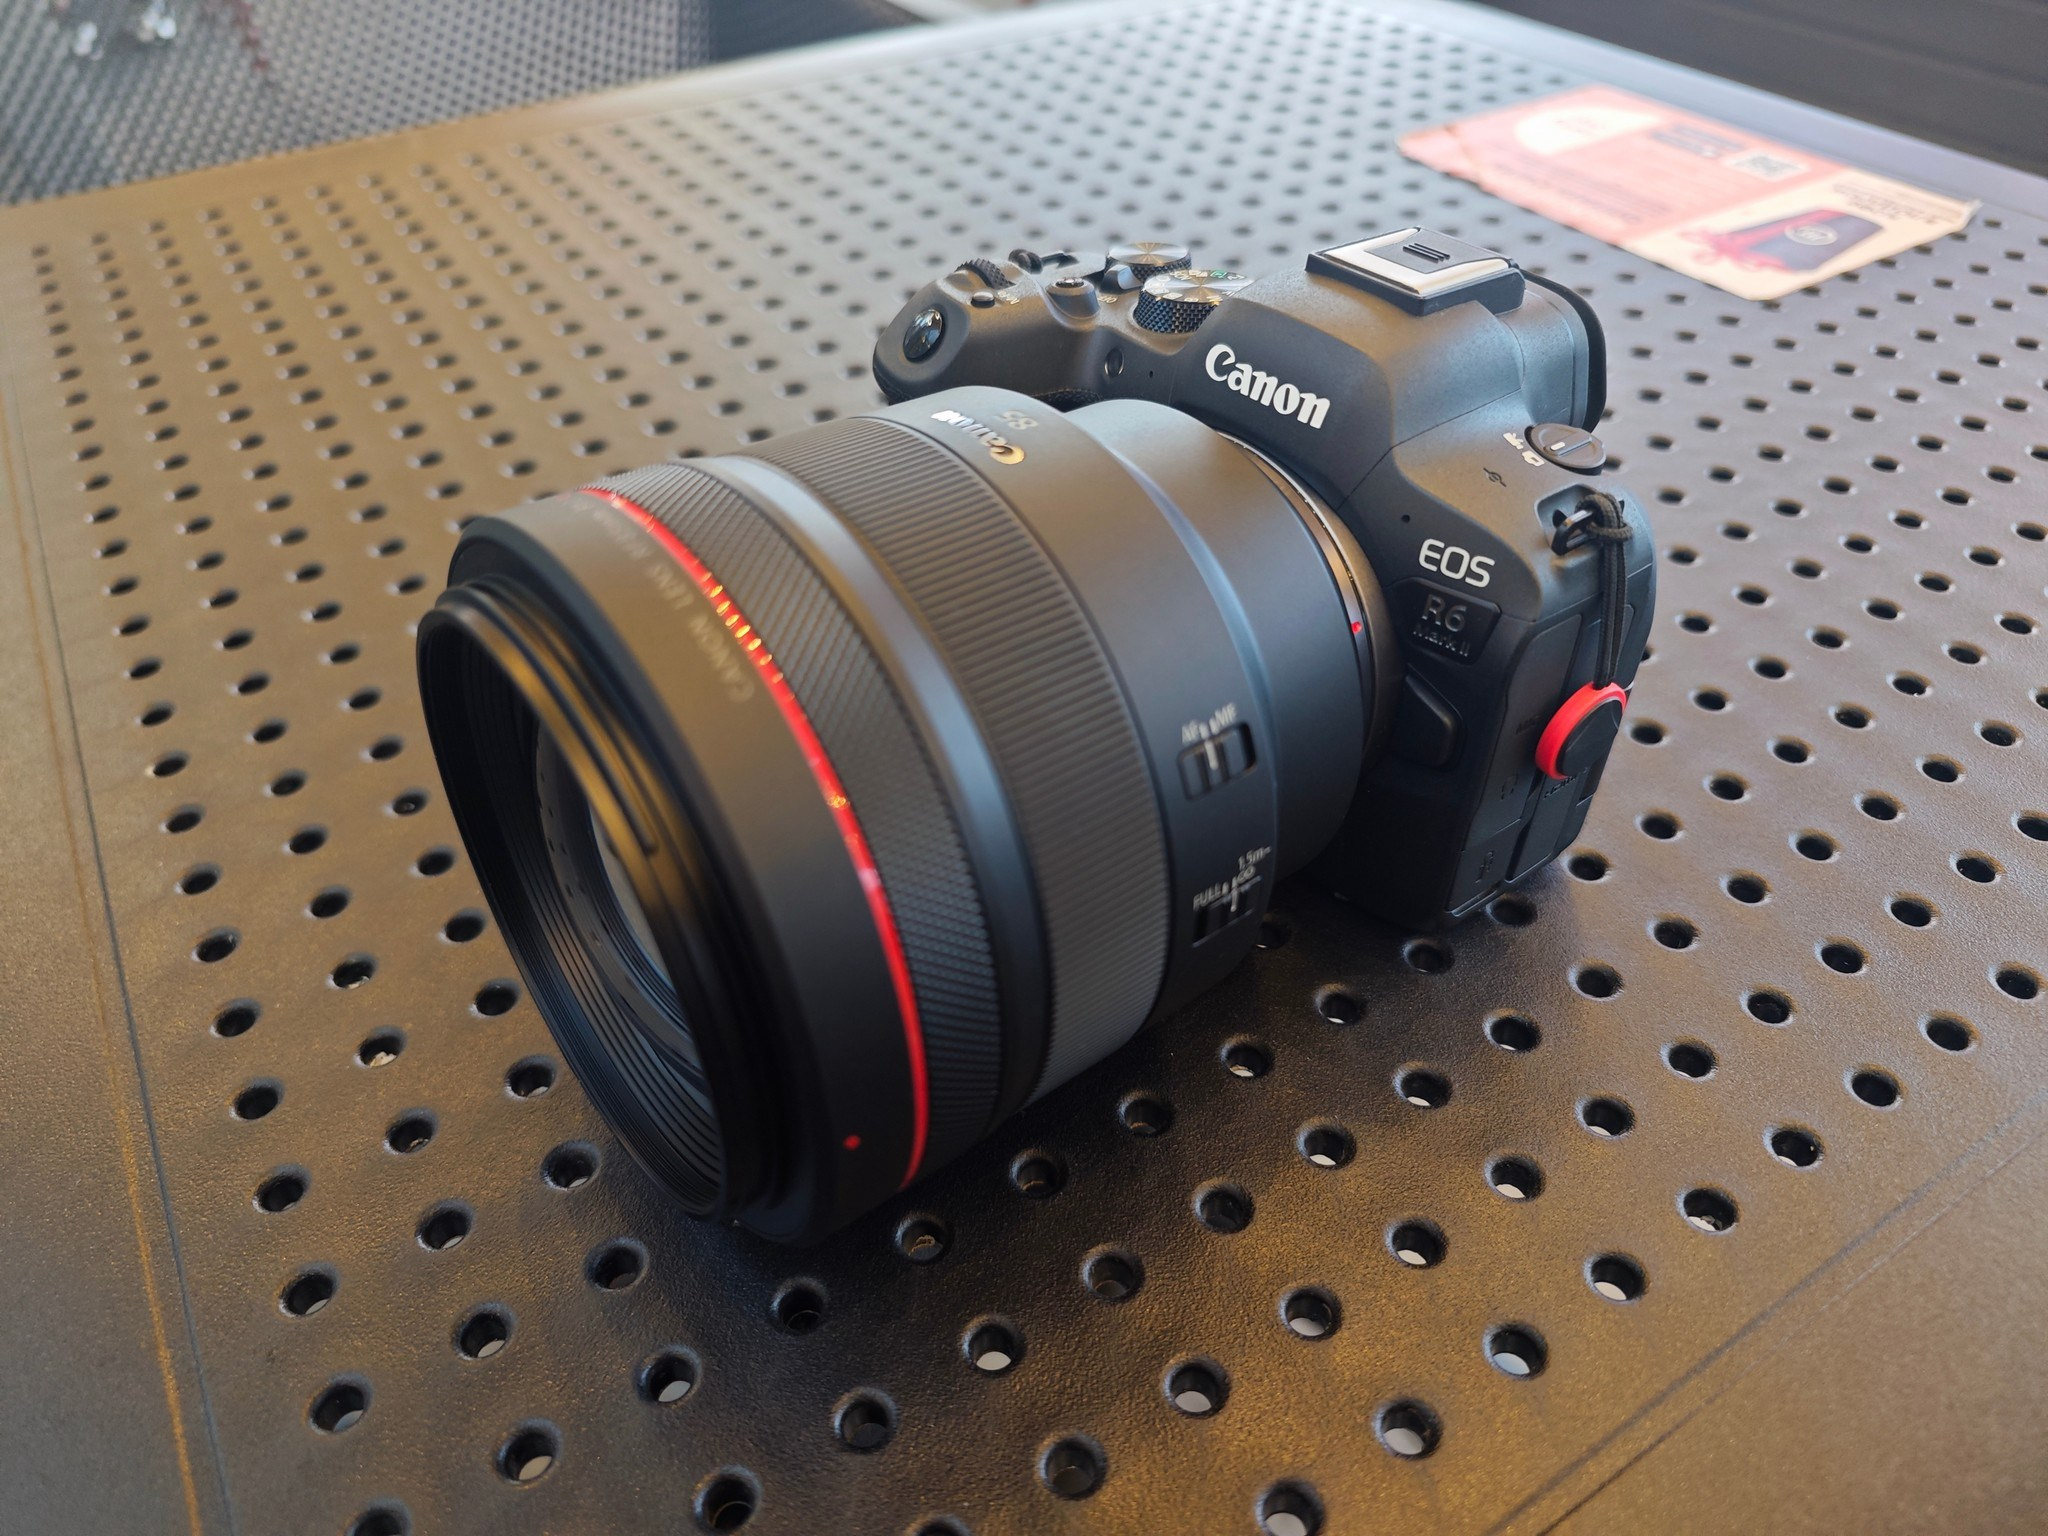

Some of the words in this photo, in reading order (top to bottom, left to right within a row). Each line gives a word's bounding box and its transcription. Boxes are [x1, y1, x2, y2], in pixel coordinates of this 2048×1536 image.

[1205, 343, 1331, 429] Canon
[1418, 538, 1496, 588] EOS
[1421, 593, 1468, 633] R6
[1181, 719, 1199, 745] AF
[1214, 701, 1237, 728] MF
[1193, 882, 1222, 911] FULL
